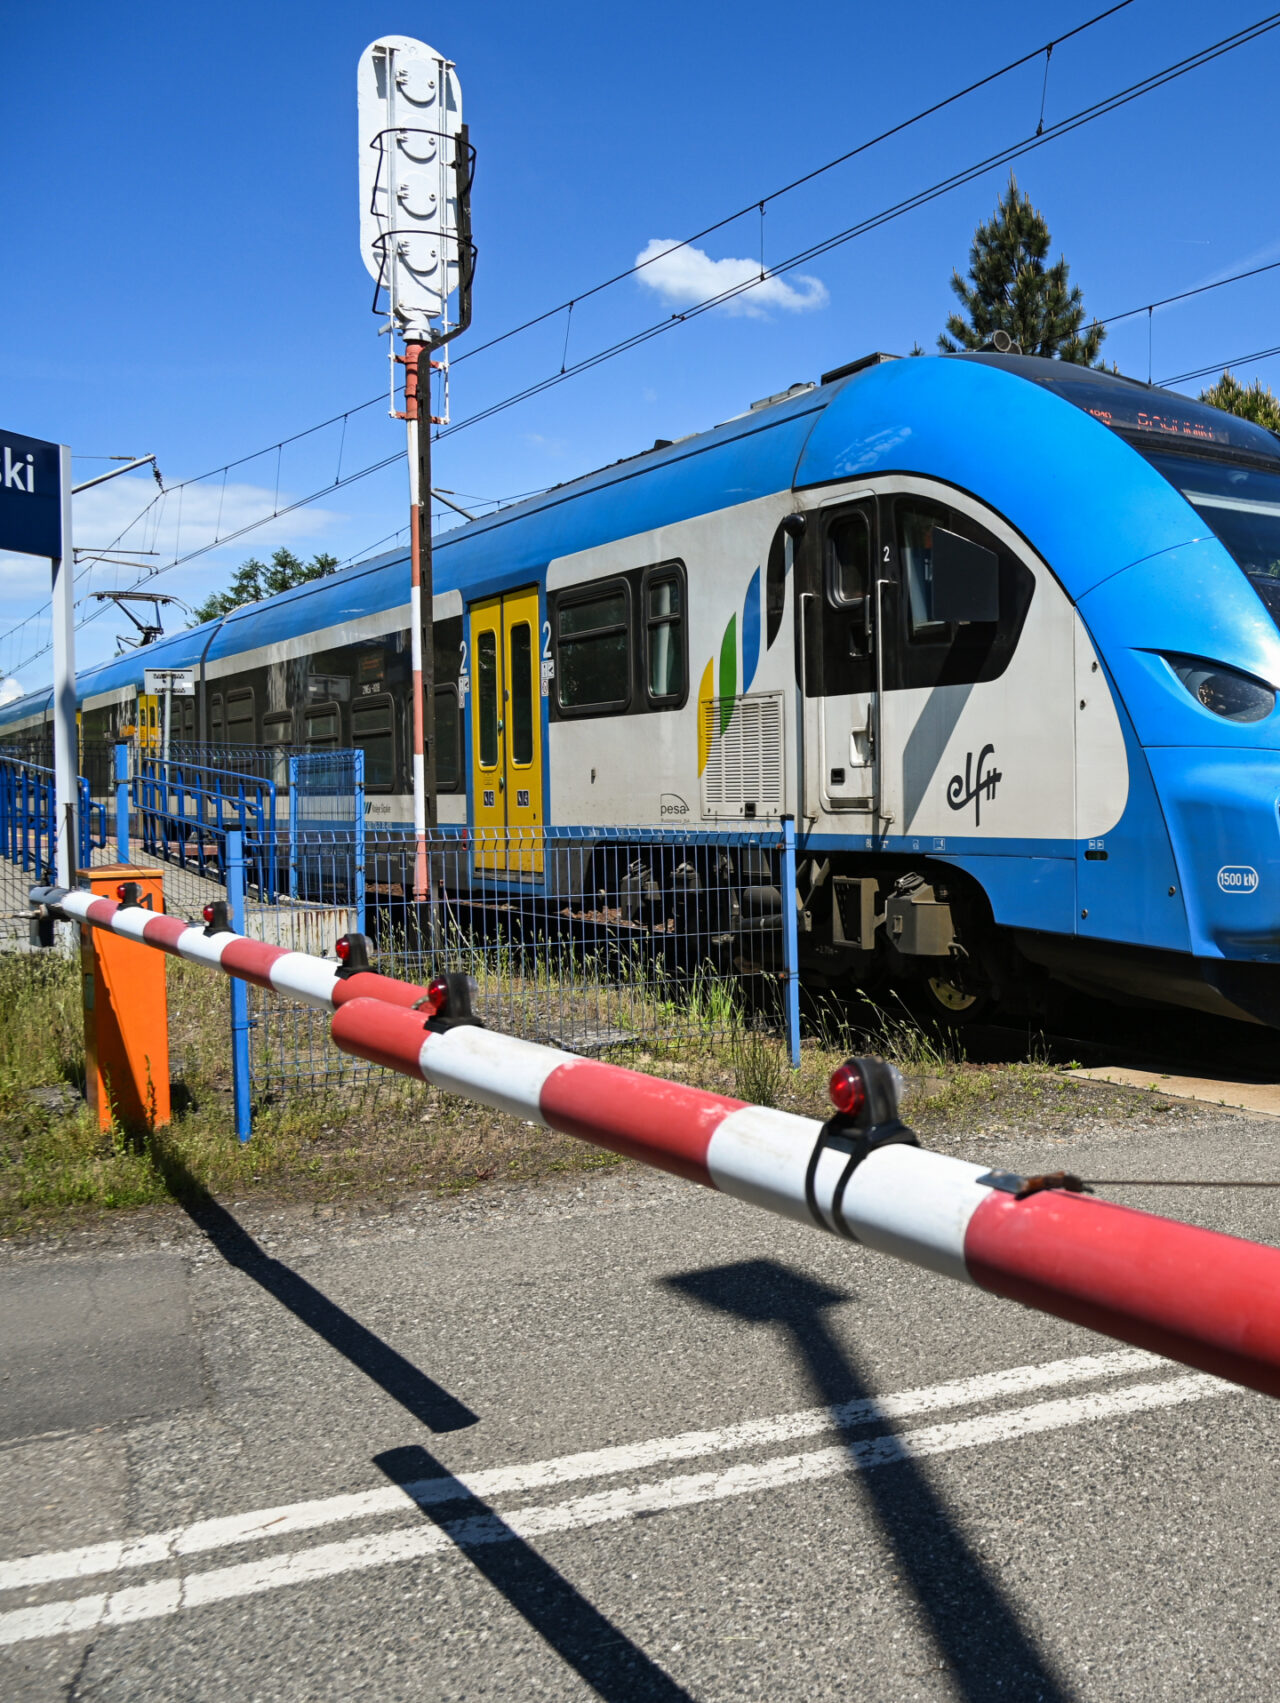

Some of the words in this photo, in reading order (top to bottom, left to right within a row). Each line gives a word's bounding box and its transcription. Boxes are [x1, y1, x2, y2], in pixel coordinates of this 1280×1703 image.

[0, 446, 34, 493] ki
[883, 546, 891, 562] 2
[542, 621, 552, 658] 2
[459, 641, 468, 674] 2
[660, 804, 687, 817] pesa
[1219, 873, 1242, 887] 1500
[1243, 873, 1256, 887] kN
